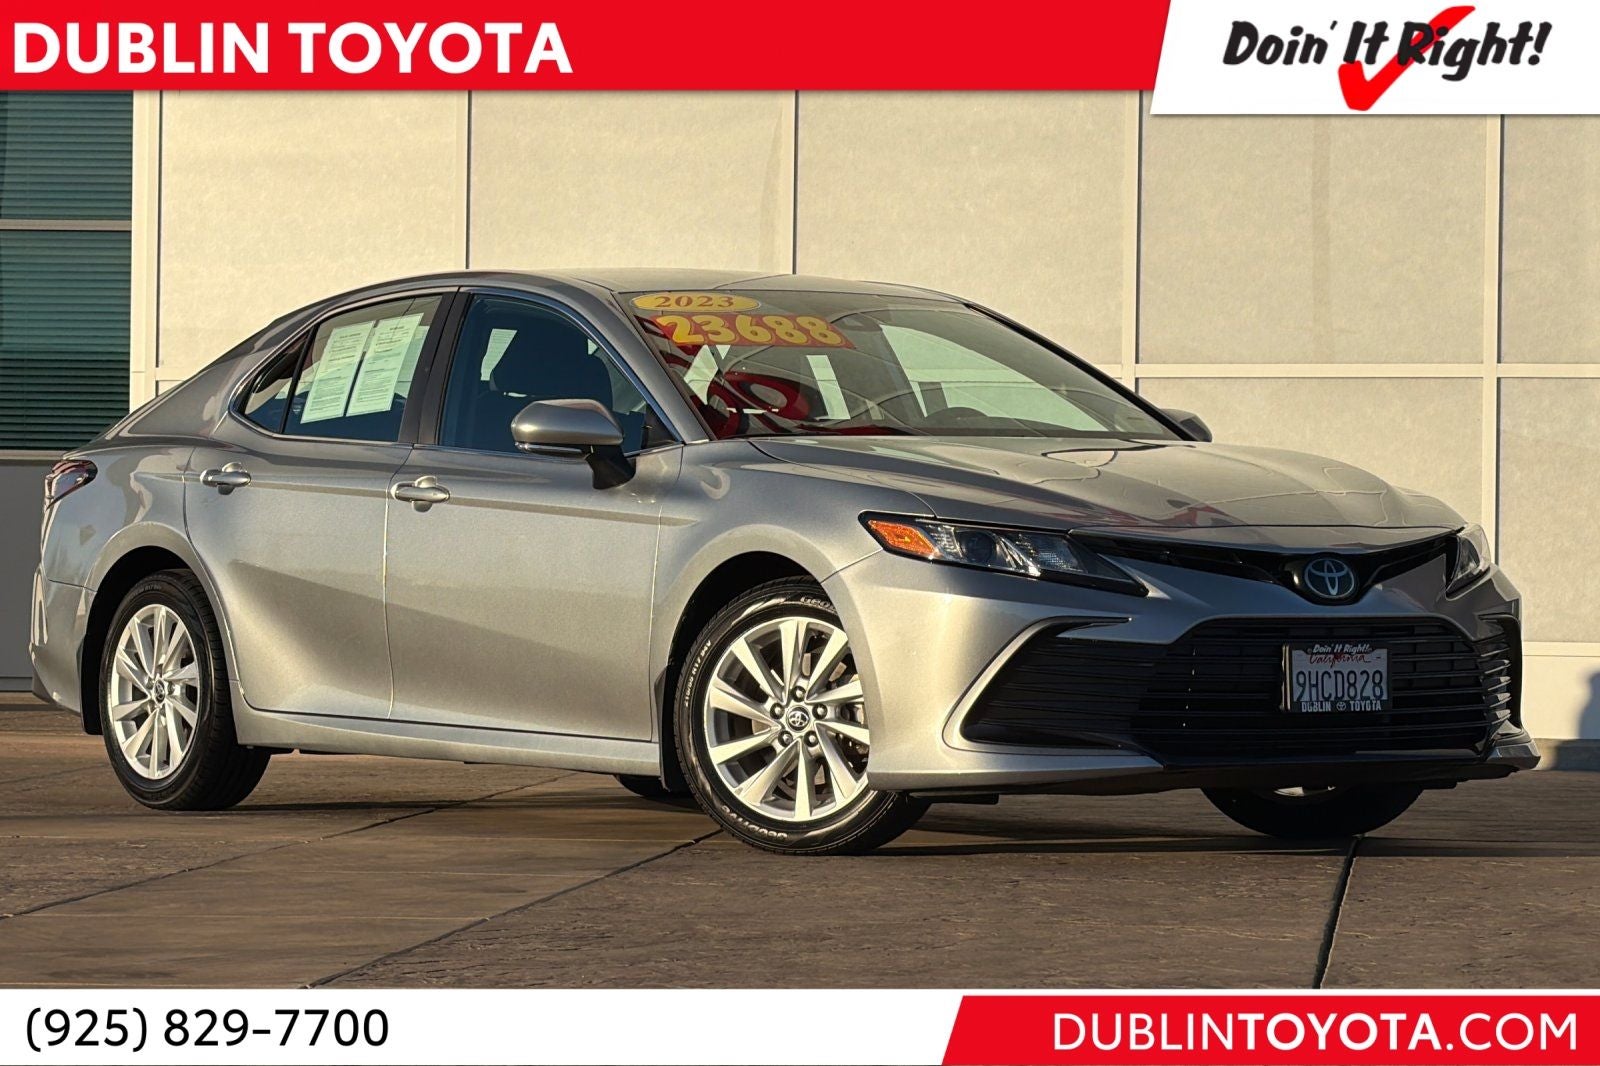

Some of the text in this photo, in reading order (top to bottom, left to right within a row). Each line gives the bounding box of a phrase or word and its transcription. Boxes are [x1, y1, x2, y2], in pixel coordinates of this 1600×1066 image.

[654, 295, 735, 308] 2023
[655, 314, 843, 345] 23688
[1334, 644, 1343, 653] It
[1343, 643, 1370, 655] Right!
[1295, 669, 1384, 701] 9HCD828
[1301, 700, 1382, 712] DUBLIN TOYOTA
